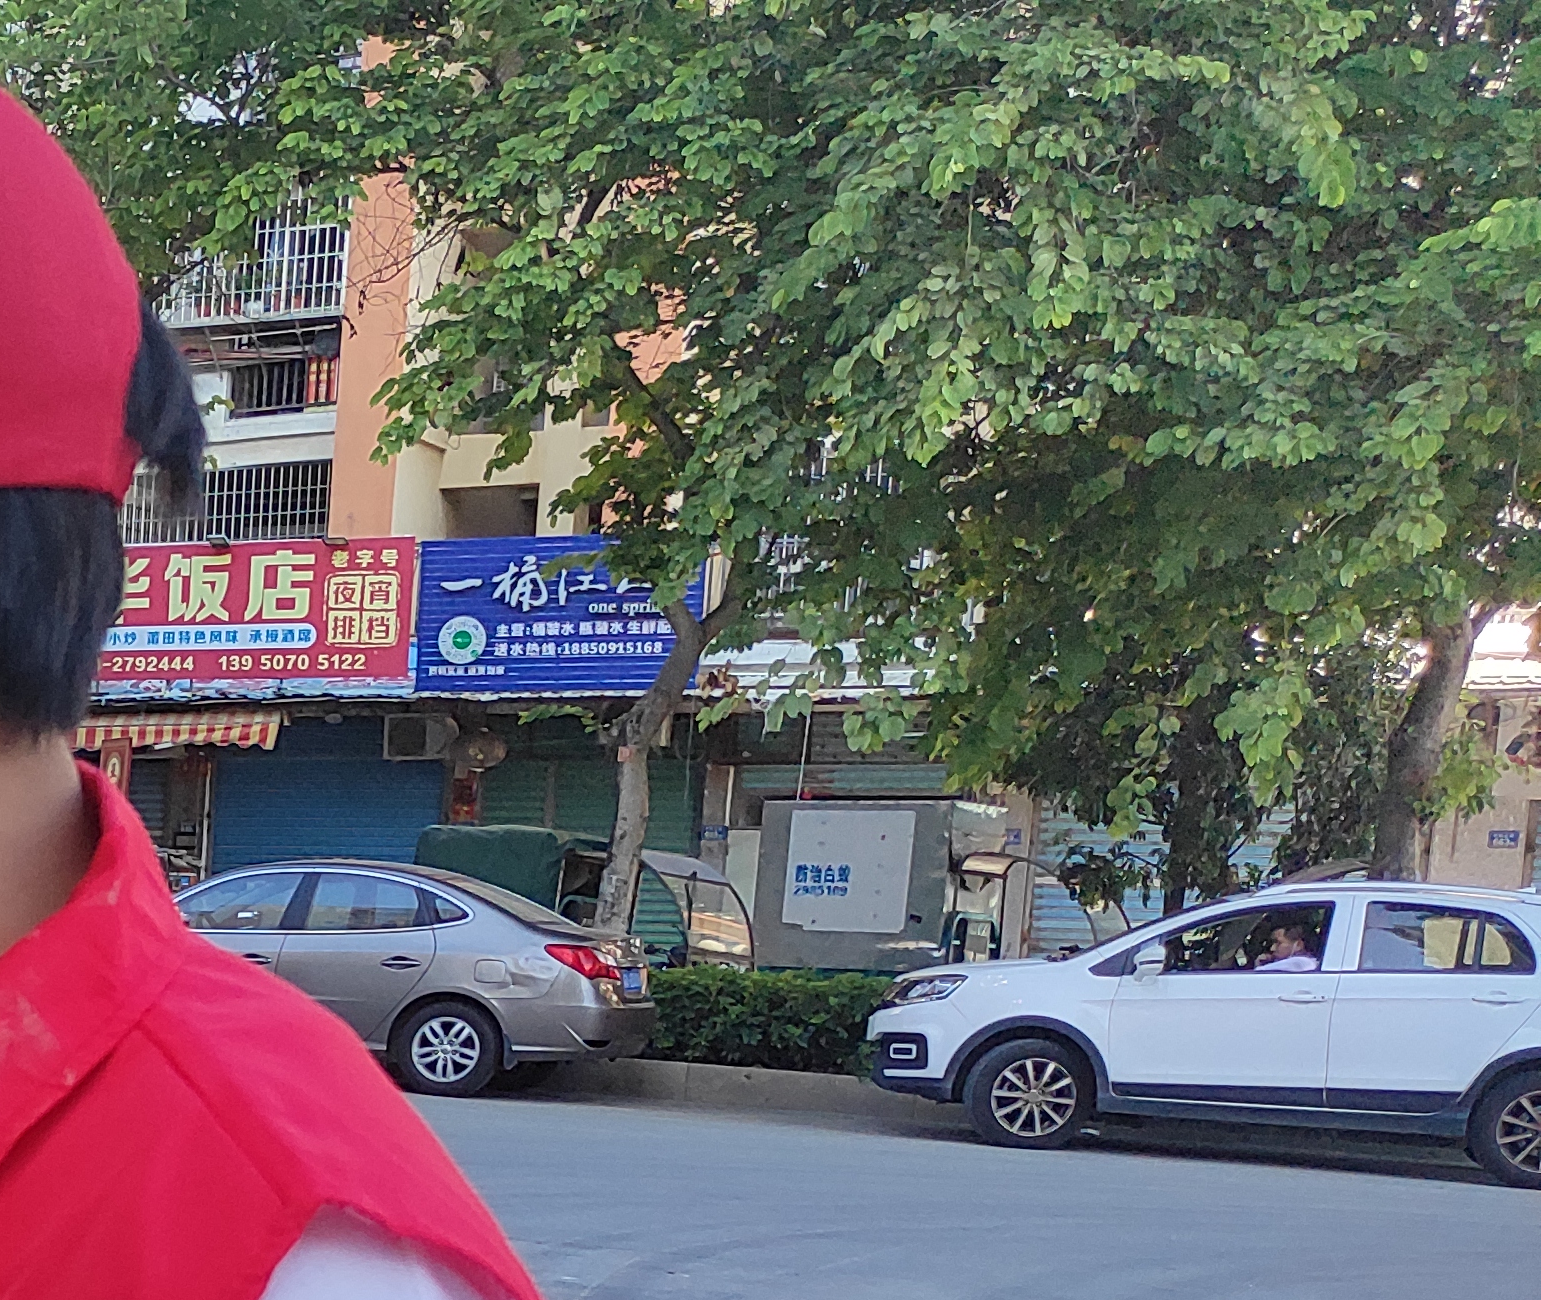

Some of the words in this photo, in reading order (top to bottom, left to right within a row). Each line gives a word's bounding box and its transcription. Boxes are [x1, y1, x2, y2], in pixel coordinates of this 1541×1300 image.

[331, 548, 399, 568] 老字号
[333, 580, 393, 606] 夜宵
[588, 602, 617, 614] one
[621, 597, 665, 617] sprin
[332, 616, 391, 640] 排档
[97, 655, 195, 672] -2792444
[218, 655, 253, 671] 139
[259, 654, 310, 671] 5070
[317, 653, 367, 670] 5122
